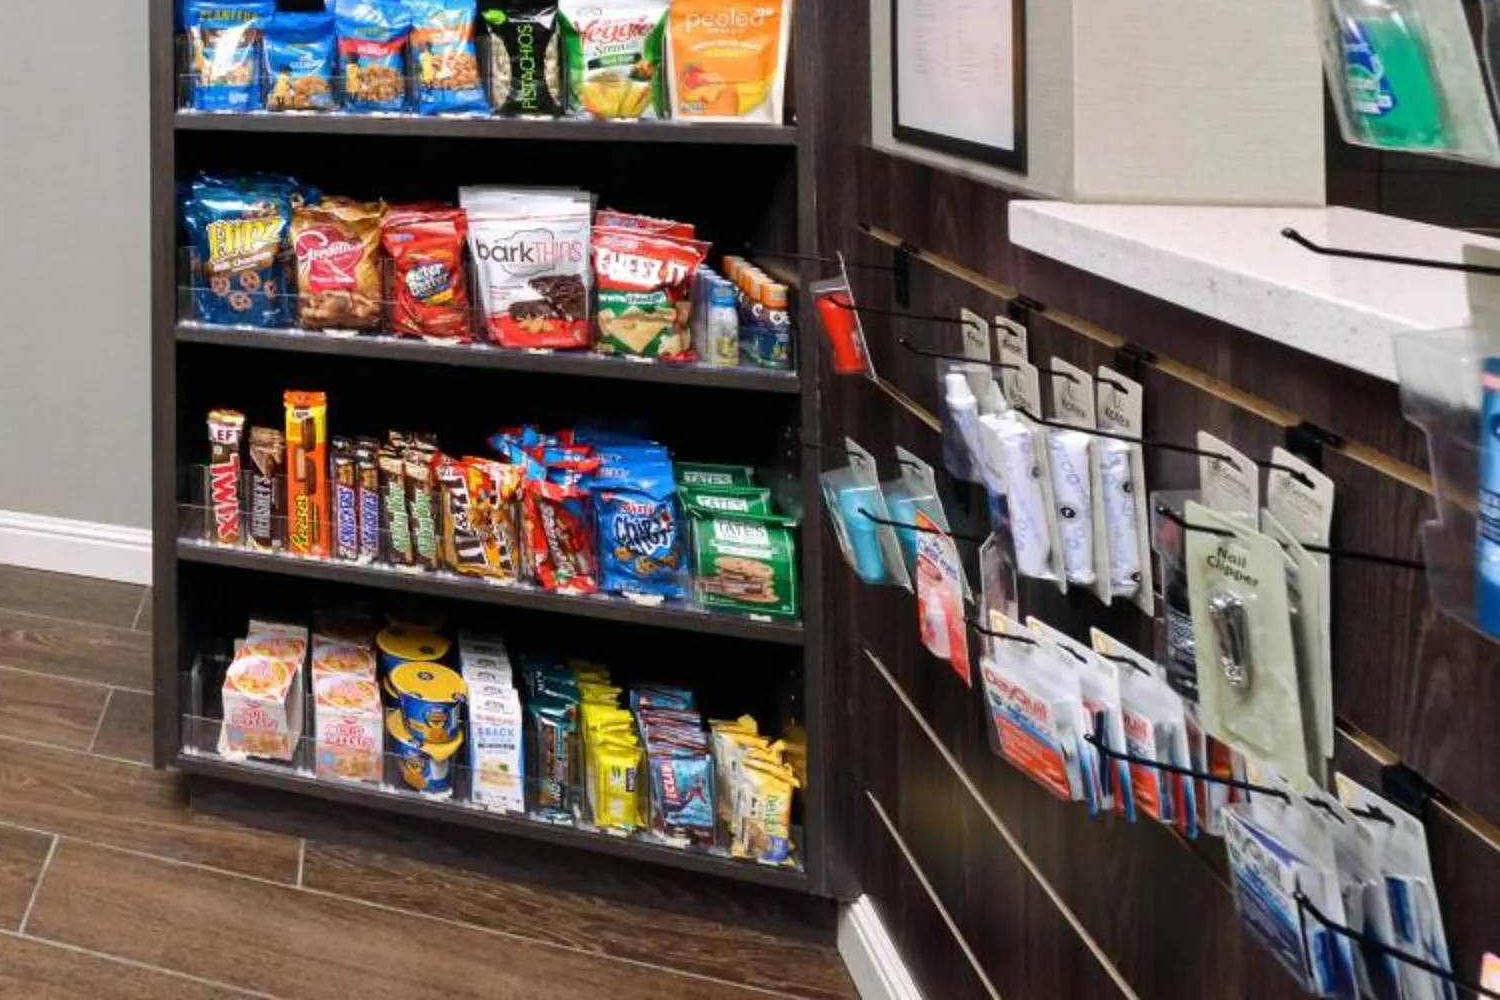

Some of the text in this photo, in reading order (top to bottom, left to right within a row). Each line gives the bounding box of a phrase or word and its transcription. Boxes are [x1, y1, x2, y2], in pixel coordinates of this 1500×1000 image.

[518, 24, 534, 110] PISTACHIOS
[475, 238, 583, 267] barkTHINS
[210, 453, 242, 539] TWIX
[252, 476, 272, 539] HERSHEY'S
[1206, 555, 1260, 589] Clipper
[1216, 546, 1247, 567] Nail
